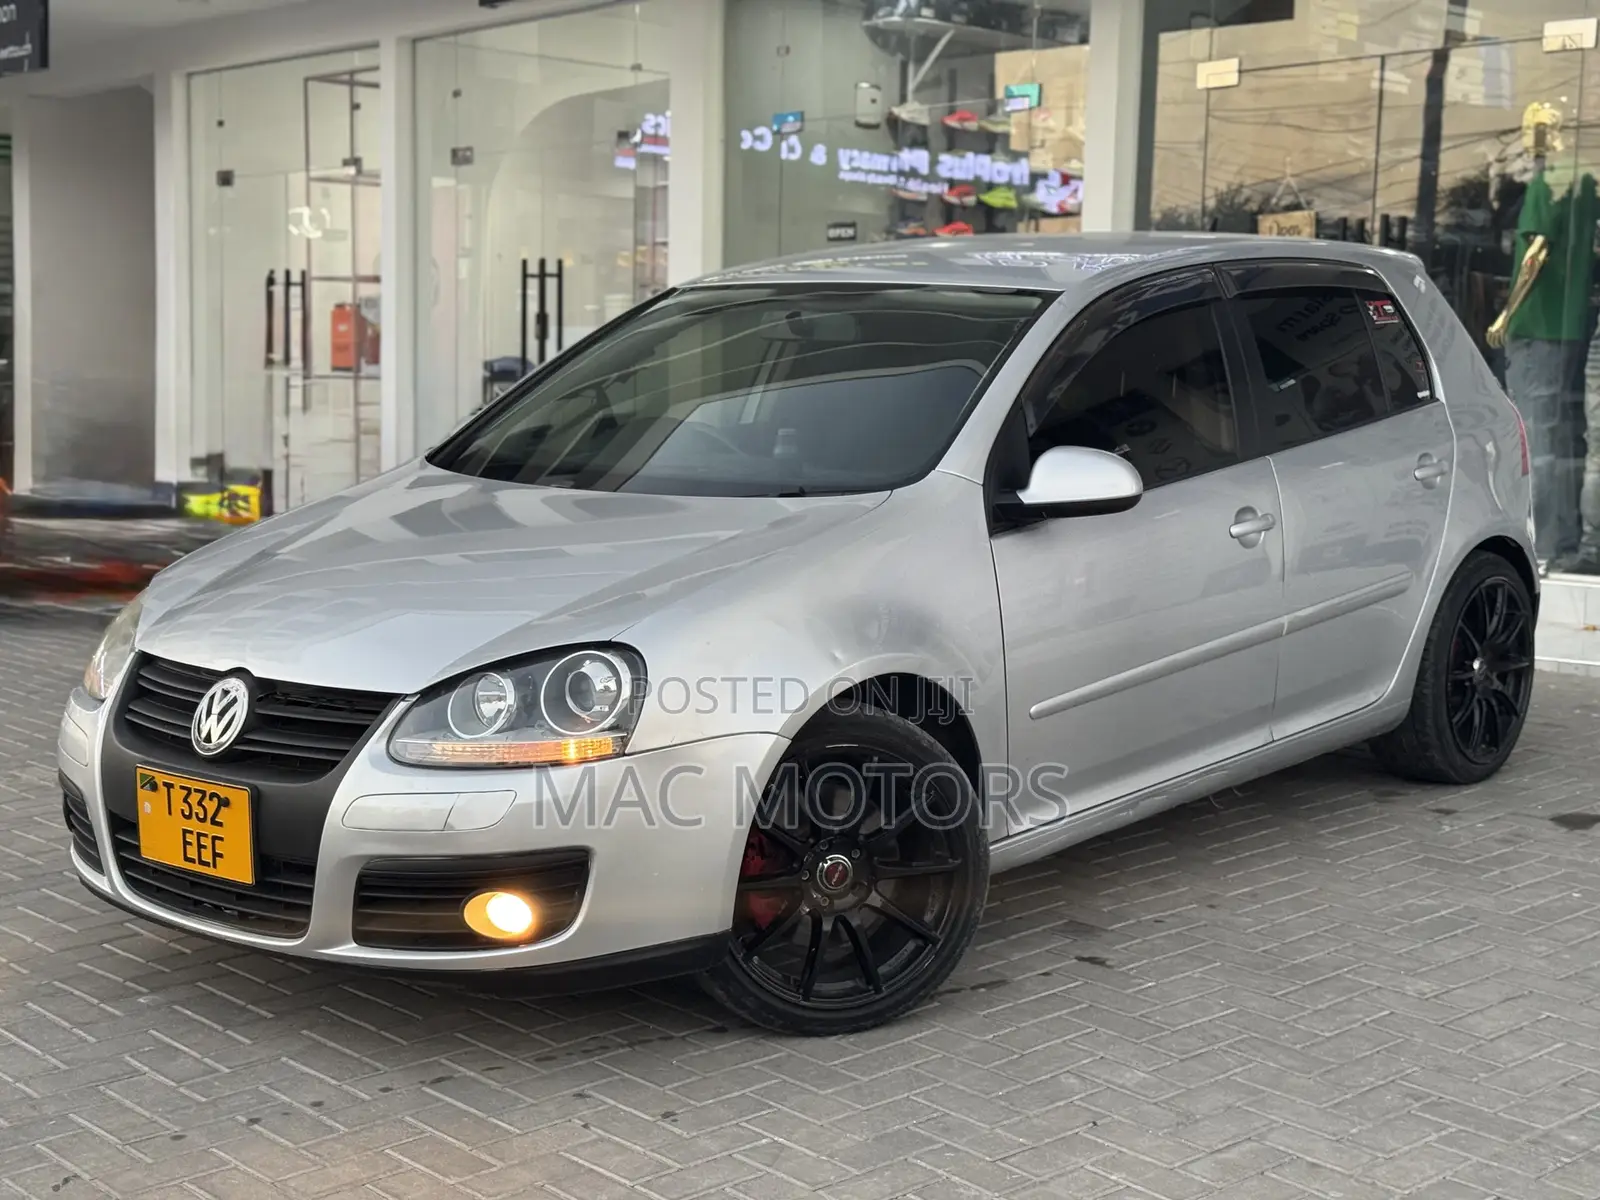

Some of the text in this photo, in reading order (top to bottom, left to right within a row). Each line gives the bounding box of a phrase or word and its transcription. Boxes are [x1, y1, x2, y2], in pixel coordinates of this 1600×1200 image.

[162, 781, 224, 828] T 332
[181, 827, 225, 870] EEF
